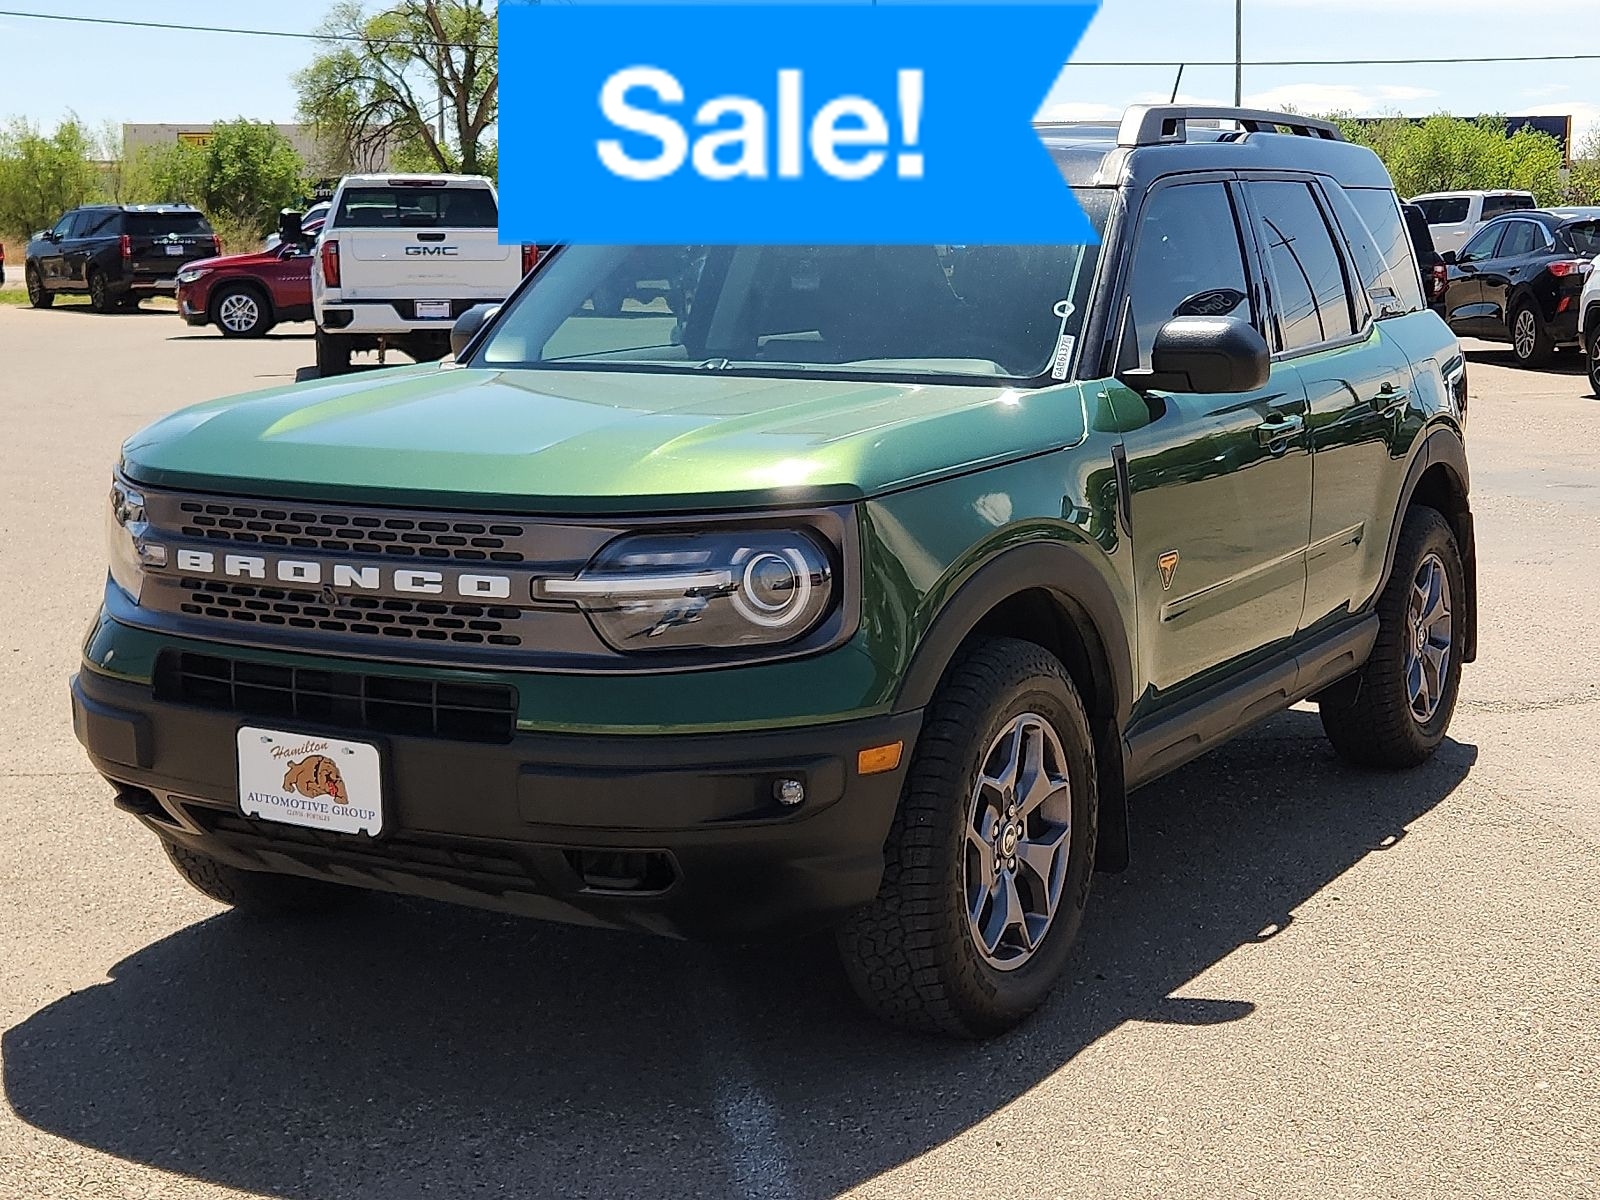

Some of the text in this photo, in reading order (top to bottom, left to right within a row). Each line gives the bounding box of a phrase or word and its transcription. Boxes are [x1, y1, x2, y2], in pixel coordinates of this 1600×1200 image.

[405, 246, 459, 256] GMC
[177, 549, 510, 598] BRONCO
[270, 741, 328, 760] Hamilton
[247, 792, 328, 814] AUTOMOTIVE
[331, 805, 376, 820] GROUP
